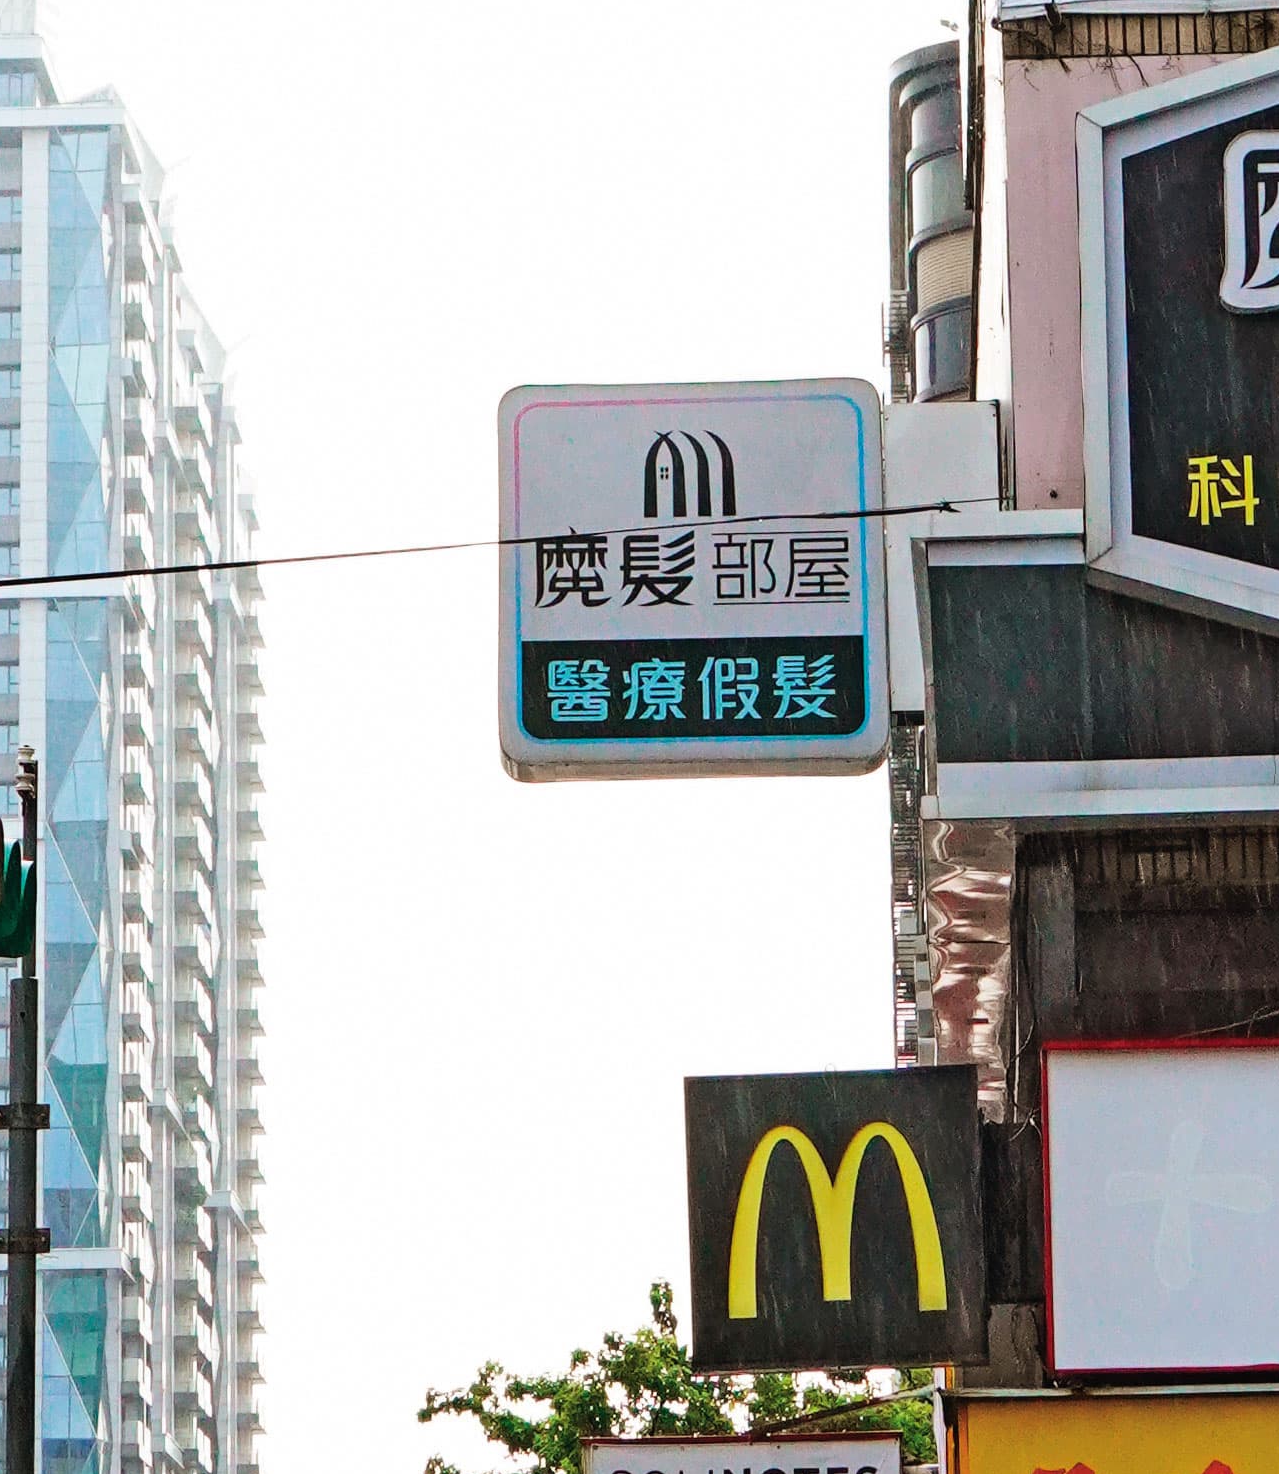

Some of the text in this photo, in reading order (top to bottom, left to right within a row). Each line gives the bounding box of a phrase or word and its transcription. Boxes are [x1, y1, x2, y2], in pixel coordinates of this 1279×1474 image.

[533, 527, 851, 609] 魔髮部屋
[546, 653, 837, 723] 醫療假髮
